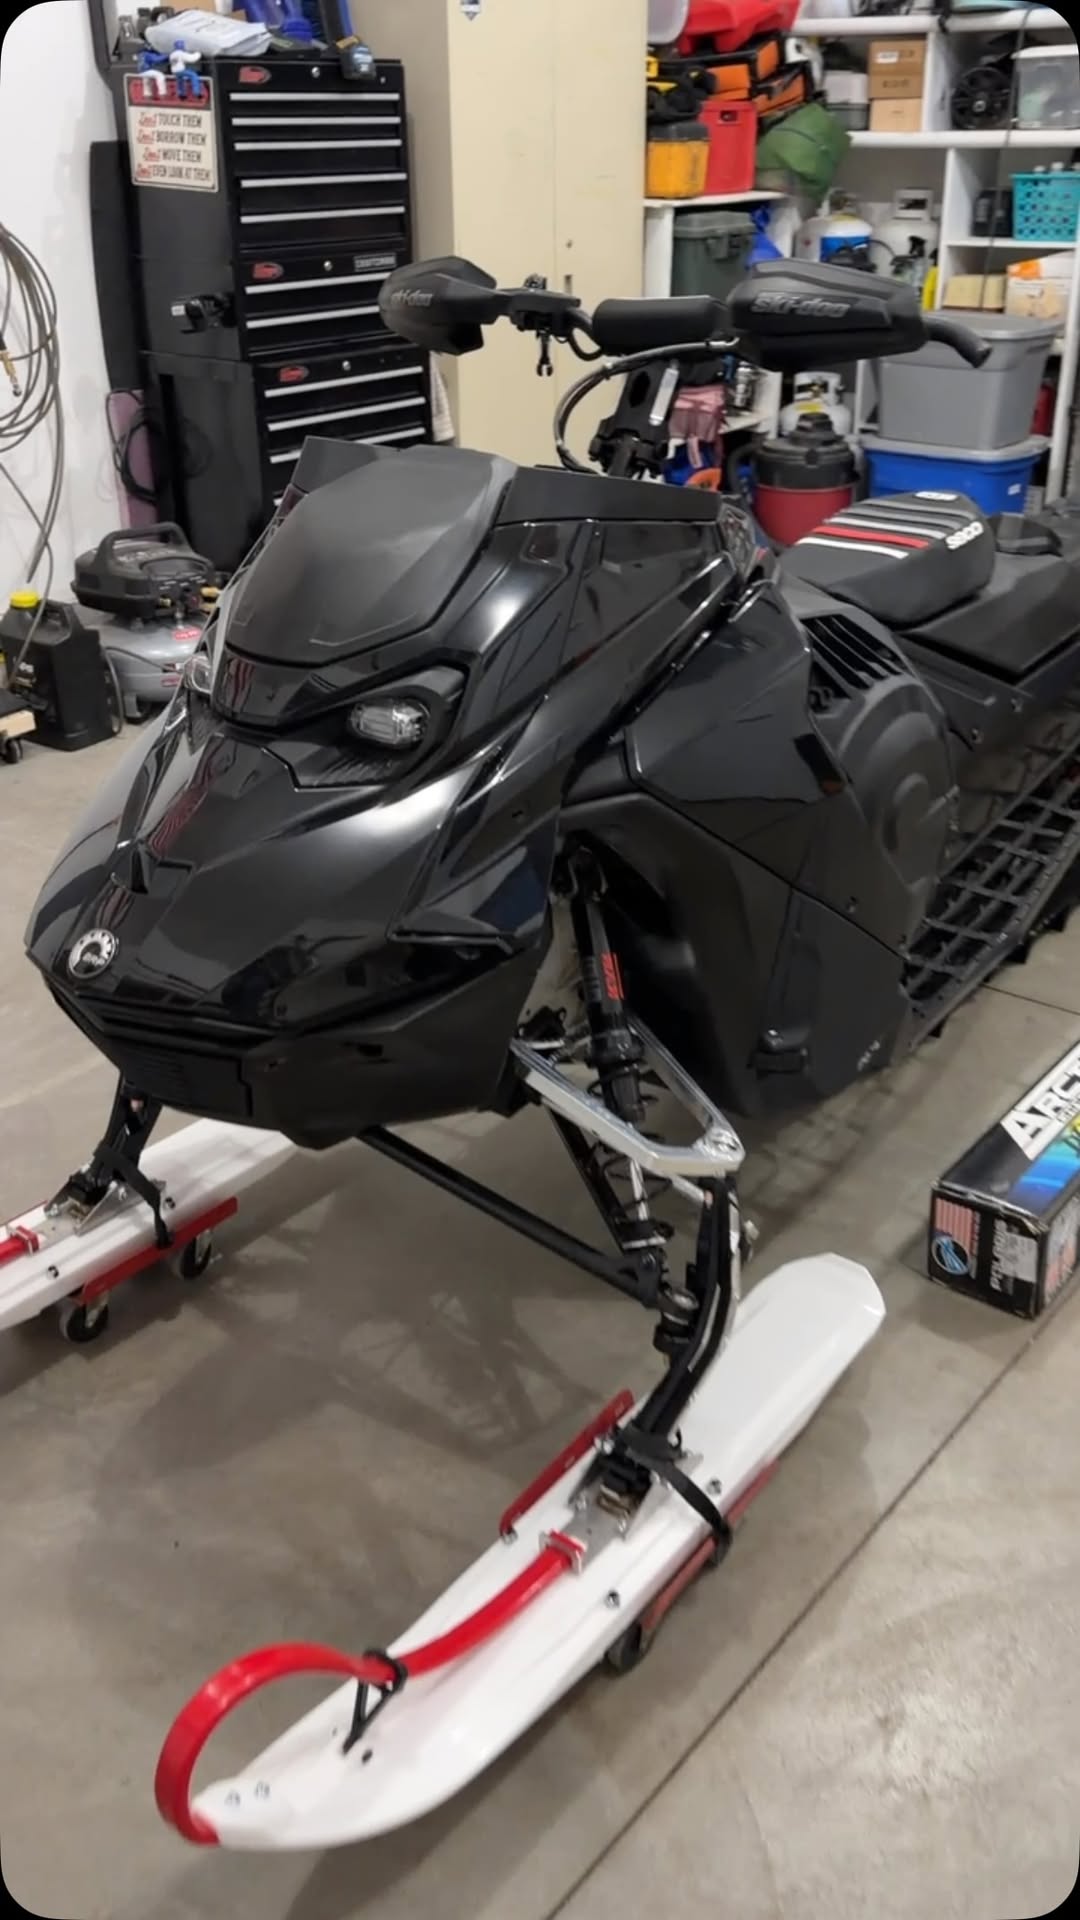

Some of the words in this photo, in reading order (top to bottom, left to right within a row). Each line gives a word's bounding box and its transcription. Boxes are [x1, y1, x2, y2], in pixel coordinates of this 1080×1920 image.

[183, 114, 202, 128] THEM
[187, 131, 206, 146] THEM
[162, 148, 181, 161] MOVE
[183, 149, 202, 162] THEM
